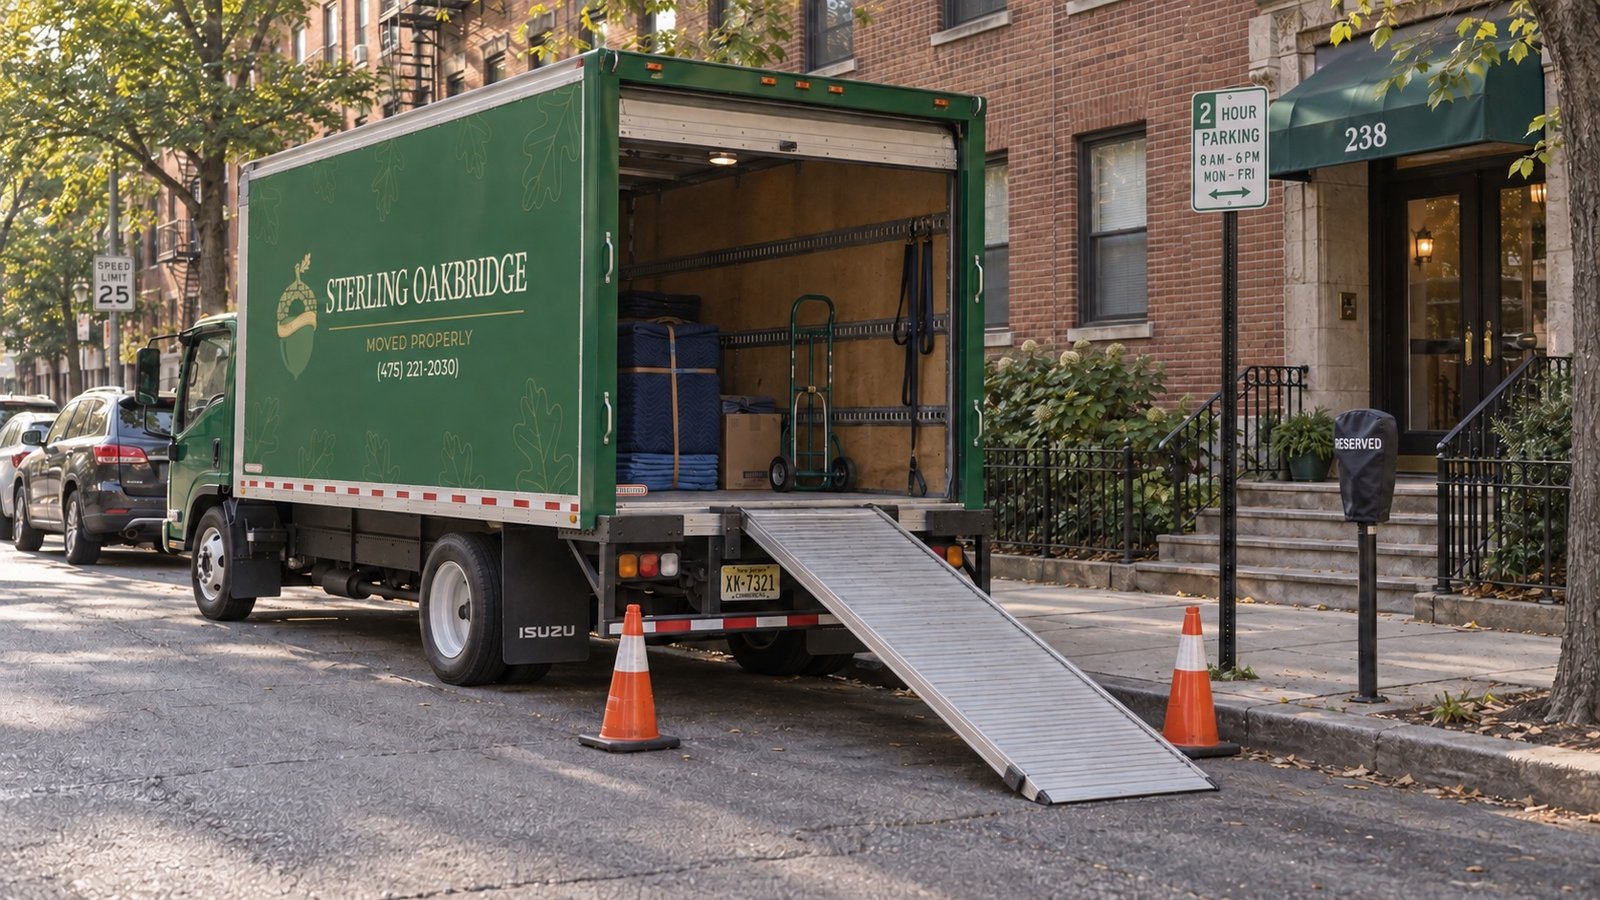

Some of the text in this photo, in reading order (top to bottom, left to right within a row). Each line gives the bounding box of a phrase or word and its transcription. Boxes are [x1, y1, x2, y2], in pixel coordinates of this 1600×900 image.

[1200, 102, 1257, 124] 2 HOUR
[1202, 128, 1260, 147] PARKING
[1344, 122, 1387, 153] 238
[1204, 170, 1226, 183] MON
[1238, 167, 1255, 180] FRI
[97, 261, 130, 271] SPEED
[101, 273, 127, 282] LIMIT
[325, 251, 527, 314] STERLING OAKBRIDGE
[99, 285, 129, 304] 25
[366, 329, 473, 352] MOVED PROPERLY
[377, 357, 459, 382] (475) 221-2030)
[1334, 437, 1382, 450] RESERVED
[519, 624, 575, 639] ISUZU
